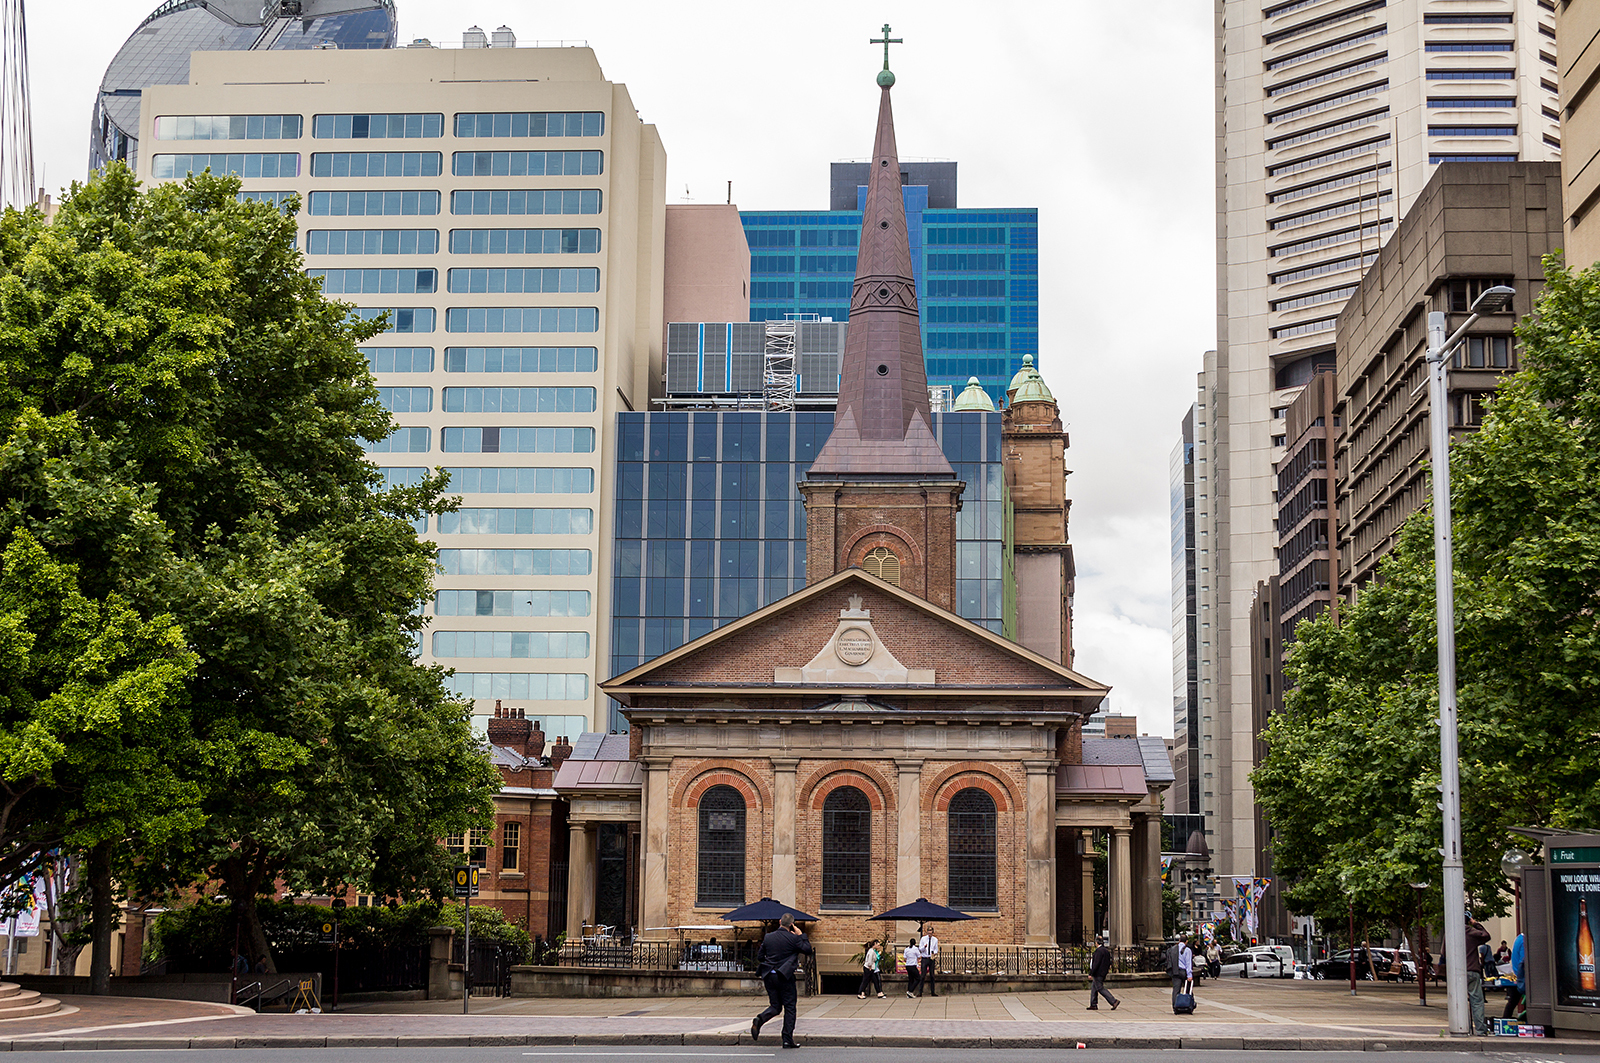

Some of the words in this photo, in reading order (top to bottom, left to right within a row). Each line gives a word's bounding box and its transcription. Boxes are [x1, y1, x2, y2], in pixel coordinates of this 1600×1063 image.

[1560, 850, 1575, 860] Fruit
[1560, 874, 1573, 883] NOW
[1573, 874, 1589, 883] LOOK
[1565, 883, 1585, 892] YOU'VE
[1585, 883, 1600, 892] DONE
